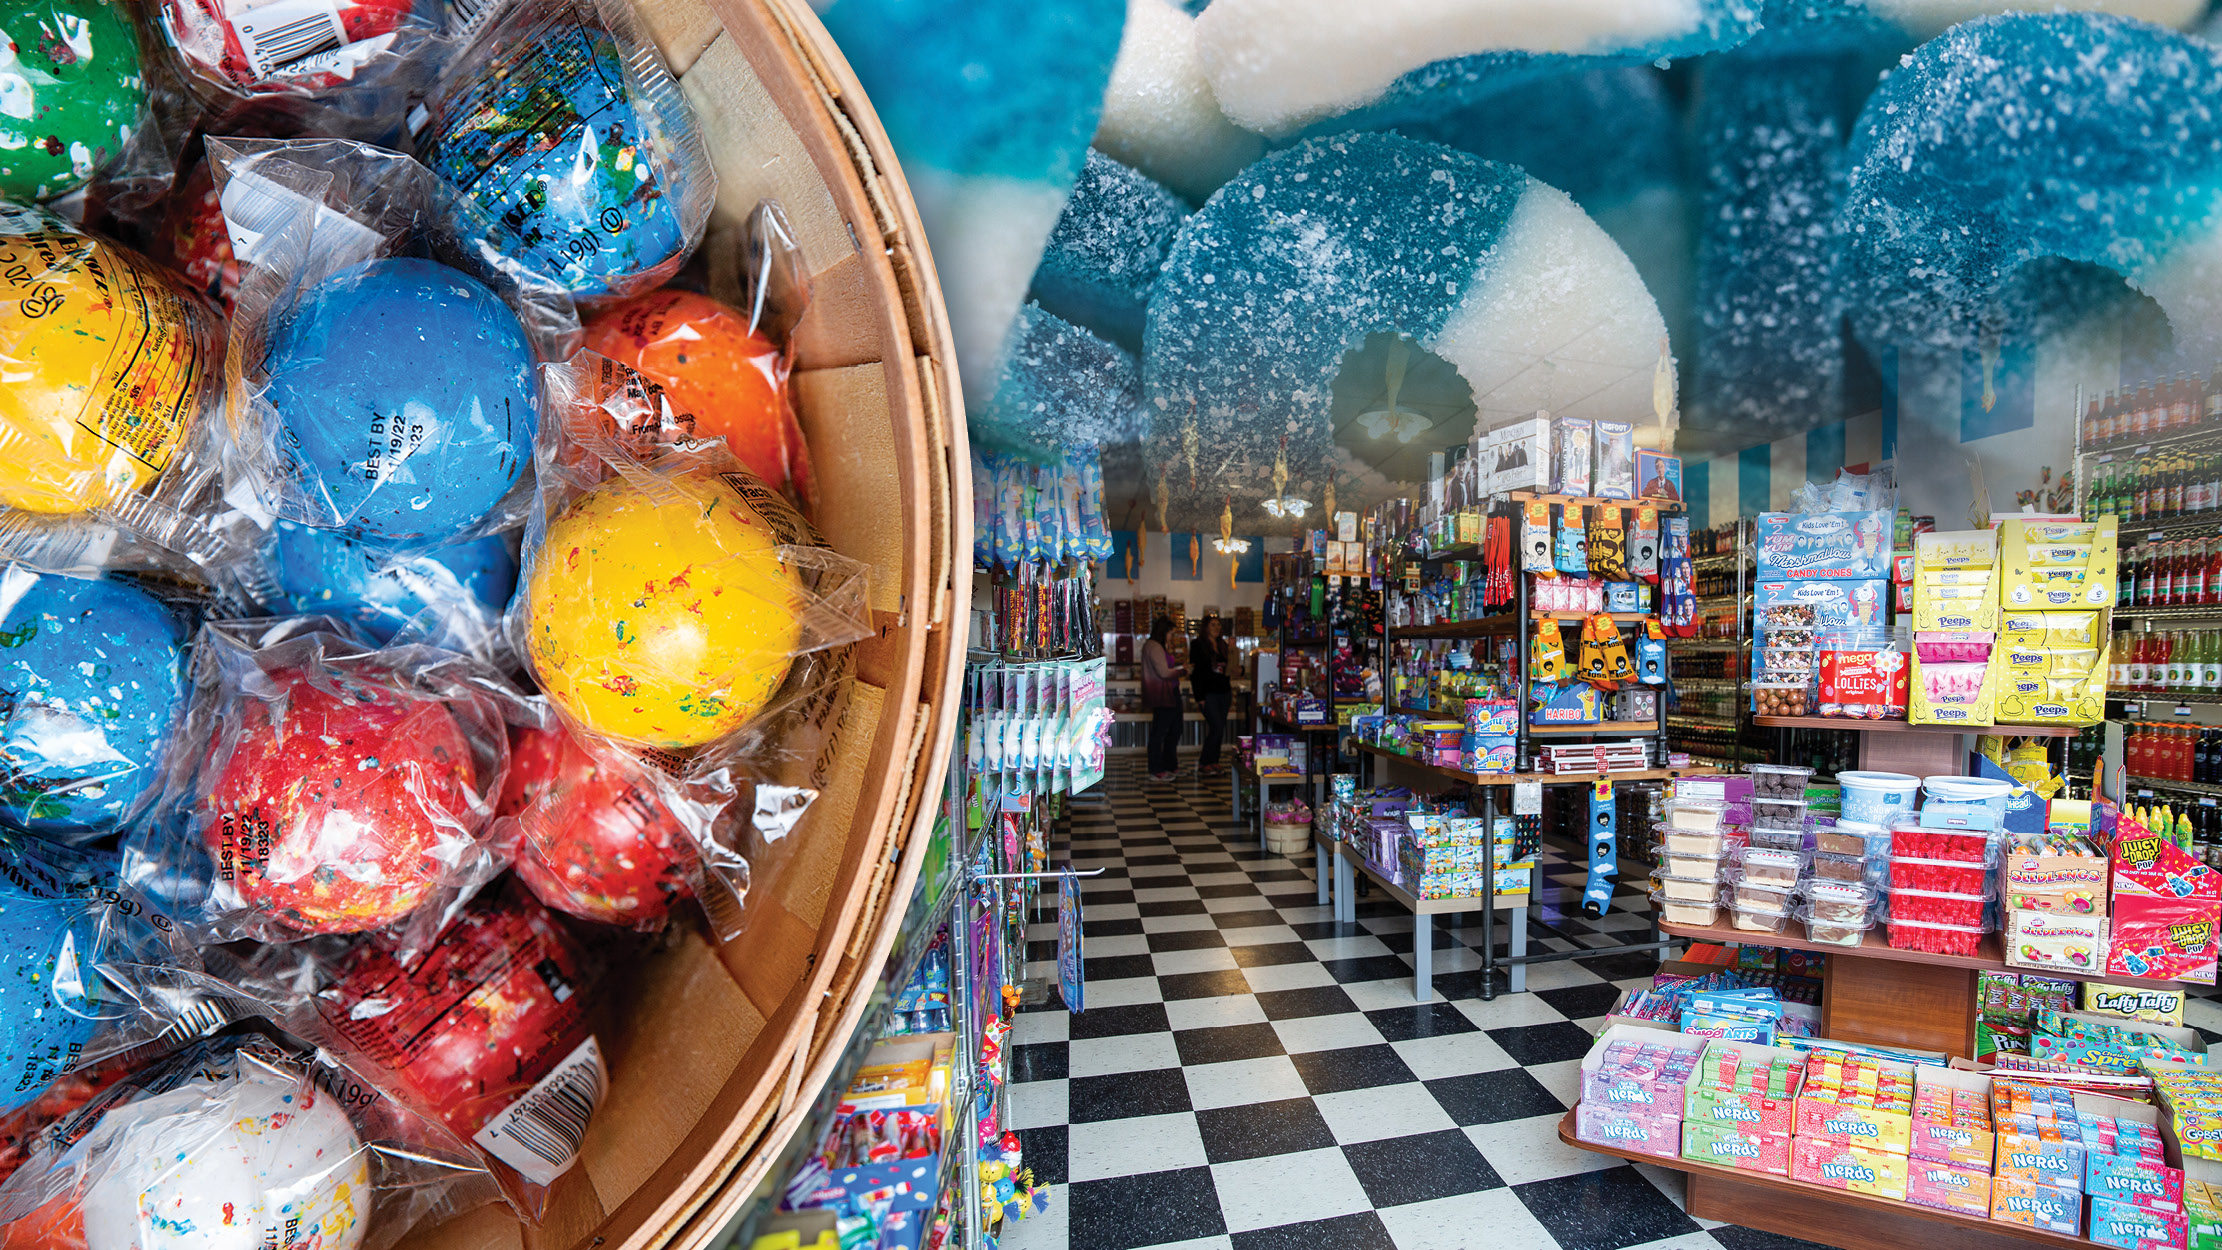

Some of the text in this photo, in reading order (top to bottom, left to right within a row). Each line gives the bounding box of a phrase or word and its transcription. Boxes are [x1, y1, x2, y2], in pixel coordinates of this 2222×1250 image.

[1601, 422, 1628, 432] BIGFOOT
[365, 412, 386, 480] BEST BY
[1772, 524, 1783, 535] 2
[1802, 521, 1815, 530] Kids
[1815, 521, 1829, 529] Love
[2043, 526, 2070, 535] Peeps
[1764, 534, 1795, 544] YUM
[1763, 543, 1795, 552] YUM
[2050, 549, 2077, 557] Peeps
[1769, 546, 1852, 569] Marshmallow
[1945, 557, 1970, 565] Peeps
[1786, 568, 1853, 578] CANDY CONES
[2047, 569, 2073, 578] Peeps
[2046, 591, 2072, 600] Peeps
[1937, 616, 1972, 627] Peeps
[1838, 653, 1873, 665] mega
[2009, 653, 2043, 665] Peeps
[1941, 694, 1966, 704] Peeps
[1545, 708, 1582, 720] HARIBO
[1933, 708, 1967, 719] Peeps
[2033, 704, 2069, 717] Peeps
[240, 814, 253, 875] 11/19/22
[257, 820, 270, 864] 18323
[2121, 837, 2160, 858] JUICY
[221, 816, 235, 881] BEST BY
[2130, 849, 2155, 863] DROP
[2136, 861, 2154, 870] POP
[2010, 868, 2102, 885] SEEDLINGS
[2115, 881, 2134, 889] NEW
[2021, 925, 2095, 938] SEEDLINGS
[2171, 922, 2210, 941] JUICY
[2180, 934, 2206, 947] DROP
[2186, 944, 2204, 954] POP
[2195, 970, 2215, 979] NEW
[2097, 991, 2179, 1013] Laffy Taffy
[1989, 1034, 2027, 1051] PUN
[62, 1042, 82, 1073] BES
[2083, 1050, 2138, 1068] Spre
[2102, 1050, 2130, 1060] Chewy
